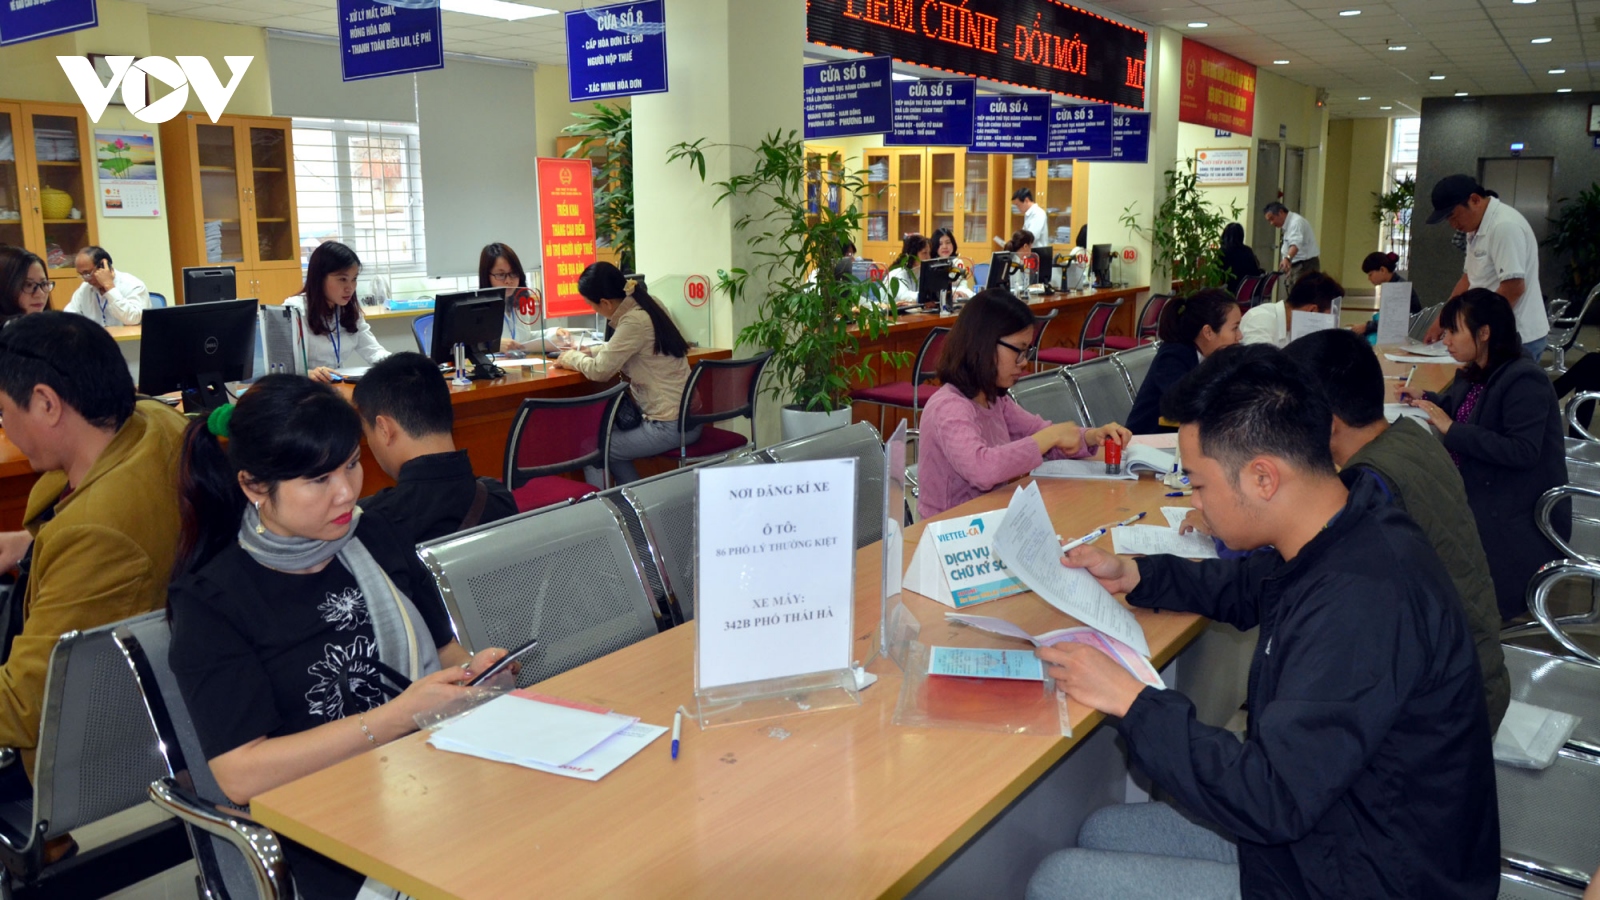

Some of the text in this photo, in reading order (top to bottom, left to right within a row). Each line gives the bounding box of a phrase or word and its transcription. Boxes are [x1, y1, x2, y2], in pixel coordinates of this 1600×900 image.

[350, 8, 357, 22] XỬ
[358, 8, 364, 21] LÝ
[597, 6, 643, 31] CỬA SỐ 8
[352, 30, 431, 54] THANH TOÁN BIÊN LAI, LỆ PHÍ
[585, 37, 596, 50] CẤP
[598, 36, 609, 48] HÓA
[610, 36, 622, 46] ĐƠN
[921, 0, 998, 53] CHÍNH
[1014, 12, 1052, 67] ĐỔI
[1053, 33, 1088, 75] MỚI
[588, 49, 632, 66] NGƯỜI NỘP THUẾ
[820, 62, 866, 82] CỬA SỐ 6
[589, 78, 642, 93] XÁC MINH HÓA ĐƠN
[909, 81, 952, 96] CỬA SỐ 5
[990, 97, 1028, 112] CỬA SỐ 4
[864, 116, 875, 124] MAI
[1056, 107, 1093, 120] CỬA SỐ 3
[1114, 115, 1130, 126] SỐ 2
[1124, 251, 1135, 259] 03
[688, 282, 705, 299] 08
[729, 489, 753, 499] NƠI
[757, 486, 793, 497] ĐĂNG
[813, 482, 830, 492] XE
[763, 521, 797, 535] Ô TÔ:
[937, 527, 979, 542] VIETTEL-CA
[716, 537, 837, 557] 86 PHỐ LÝ THƯỜNG KIỆT
[945, 546, 989, 566] DỊCH VỤ
[951, 565, 974, 580] CHỮ
[976, 561, 990, 575] KÝ
[753, 593, 805, 609] XE MÁY:
[724, 607, 833, 631] 342B PHỐ THÁI HÀ
